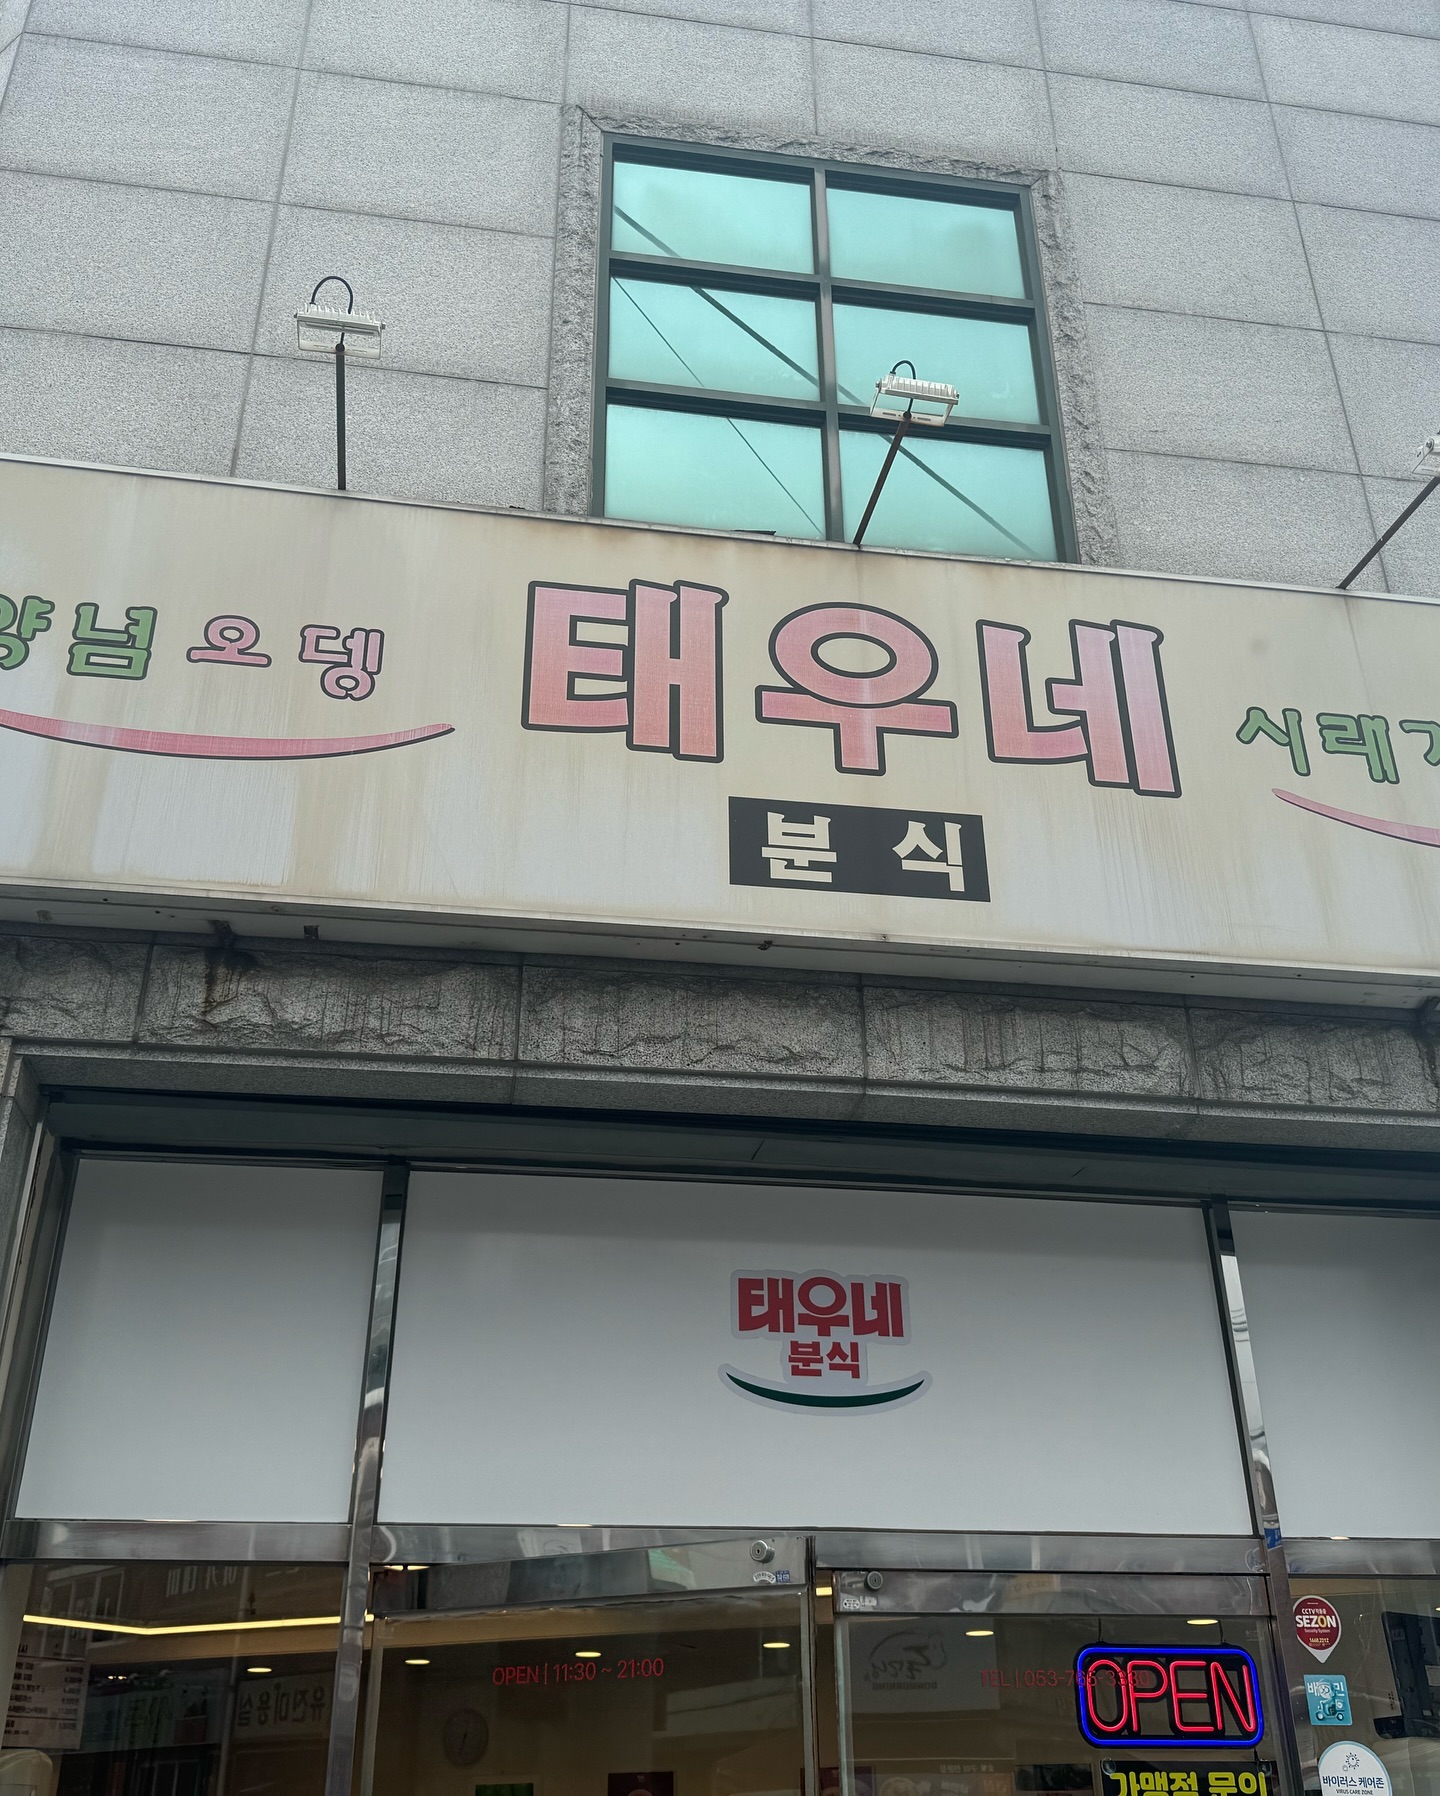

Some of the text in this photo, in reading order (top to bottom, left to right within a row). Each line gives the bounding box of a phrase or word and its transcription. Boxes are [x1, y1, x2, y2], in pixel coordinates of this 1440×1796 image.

[186, 614, 385, 701] 오뎅
[521, 578, 1183, 799] 태우네
[738, 1276, 904, 1337] 태우네
[788, 1340, 860, 1379] 분식
[1295, 1615, 1337, 1628] SEZON
[492, 1665, 539, 1686] OPEN
[553, 1662, 596, 1682] 11:30
[617, 1658, 665, 1679] 21:00
[980, 1669, 1011, 1688] TEL
[1088, 1659, 1257, 1732] OPEN
[1322, 1775, 1384, 1789] 바이러스 케어존
